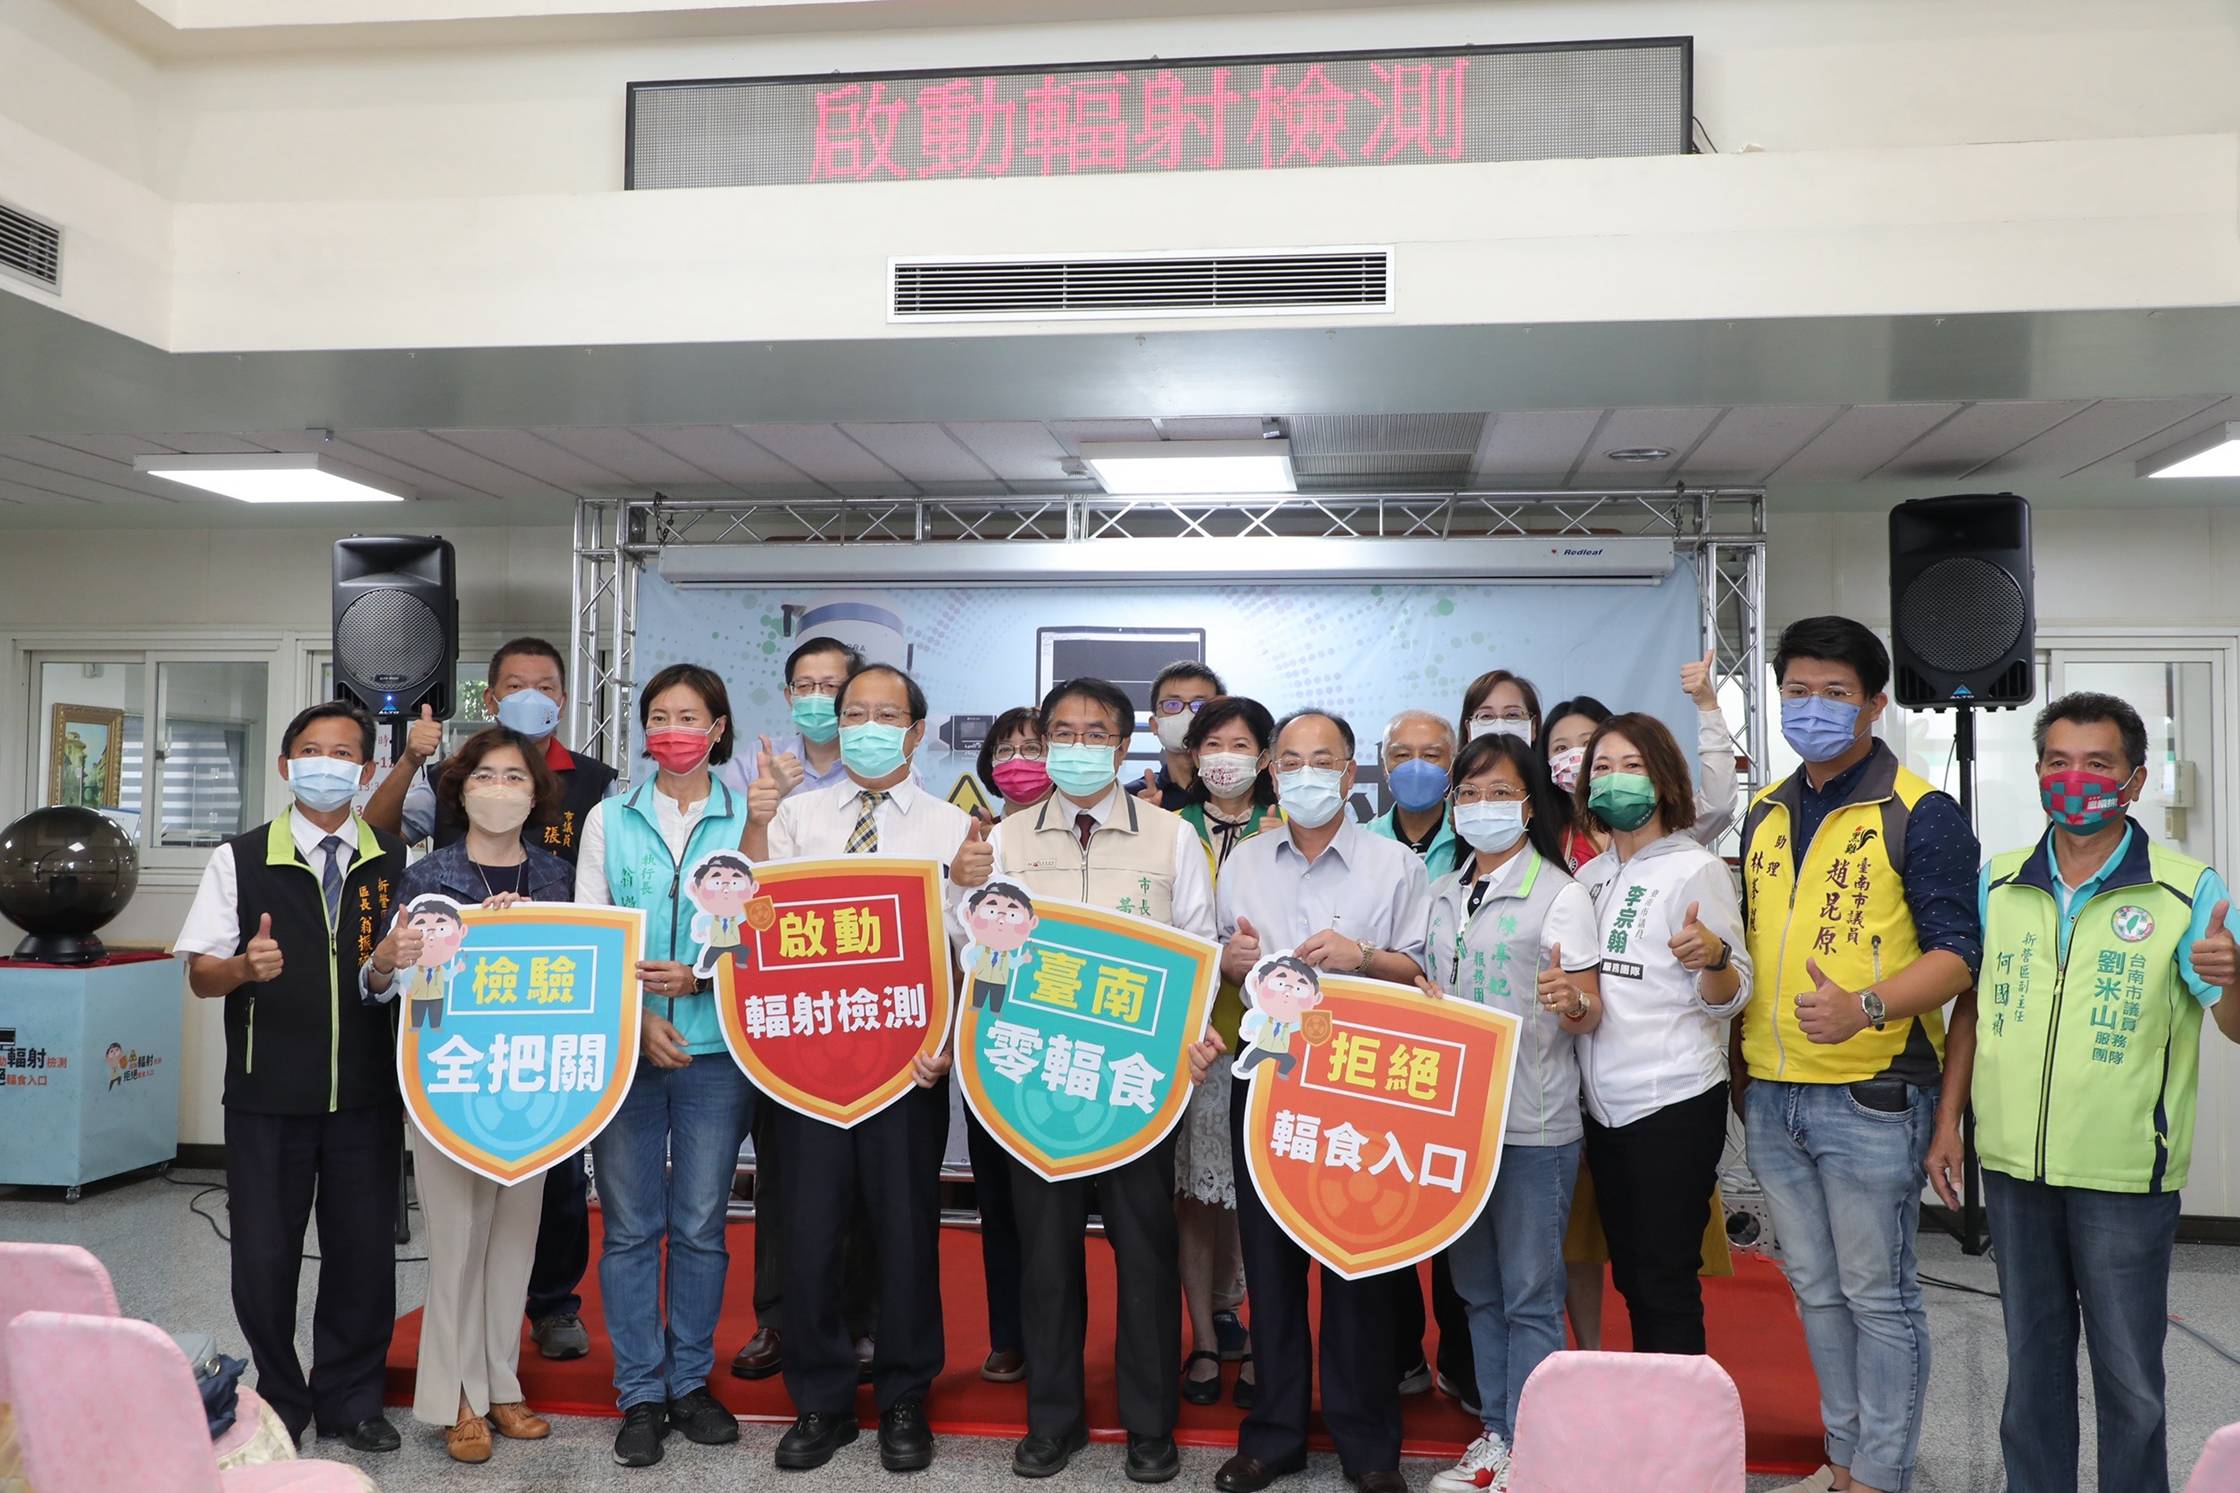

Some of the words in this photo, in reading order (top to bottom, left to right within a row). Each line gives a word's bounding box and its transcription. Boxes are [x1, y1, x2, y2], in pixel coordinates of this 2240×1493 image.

[808, 57, 1470, 181] 啟動輻射檢測
[1563, 548, 1603, 556] Redleaf
[1138, 877, 1151, 917] 市長
[1606, 885, 1648, 954] 李宗翰
[1812, 857, 1851, 956] 趙昆原
[1846, 857, 1872, 946] 臺南市議員
[779, 906, 882, 959] 啟動
[472, 955, 577, 1005] 檢驗
[744, 983, 928, 1039] 輻射檢測
[1029, 949, 1149, 1024] 臺南
[2089, 949, 2127, 1030] 劉米山
[2120, 952, 2147, 1034] 台南市議員
[427, 1033, 606, 1094] 全把關
[983, 1019, 1167, 1115] 零輻食
[1327, 1031, 1441, 1101] 拒絕
[2092, 1047, 2125, 1065] 團隊
[2095, 1031, 2128, 1048] 服務
[1270, 1109, 1467, 1194] 輻食入口
